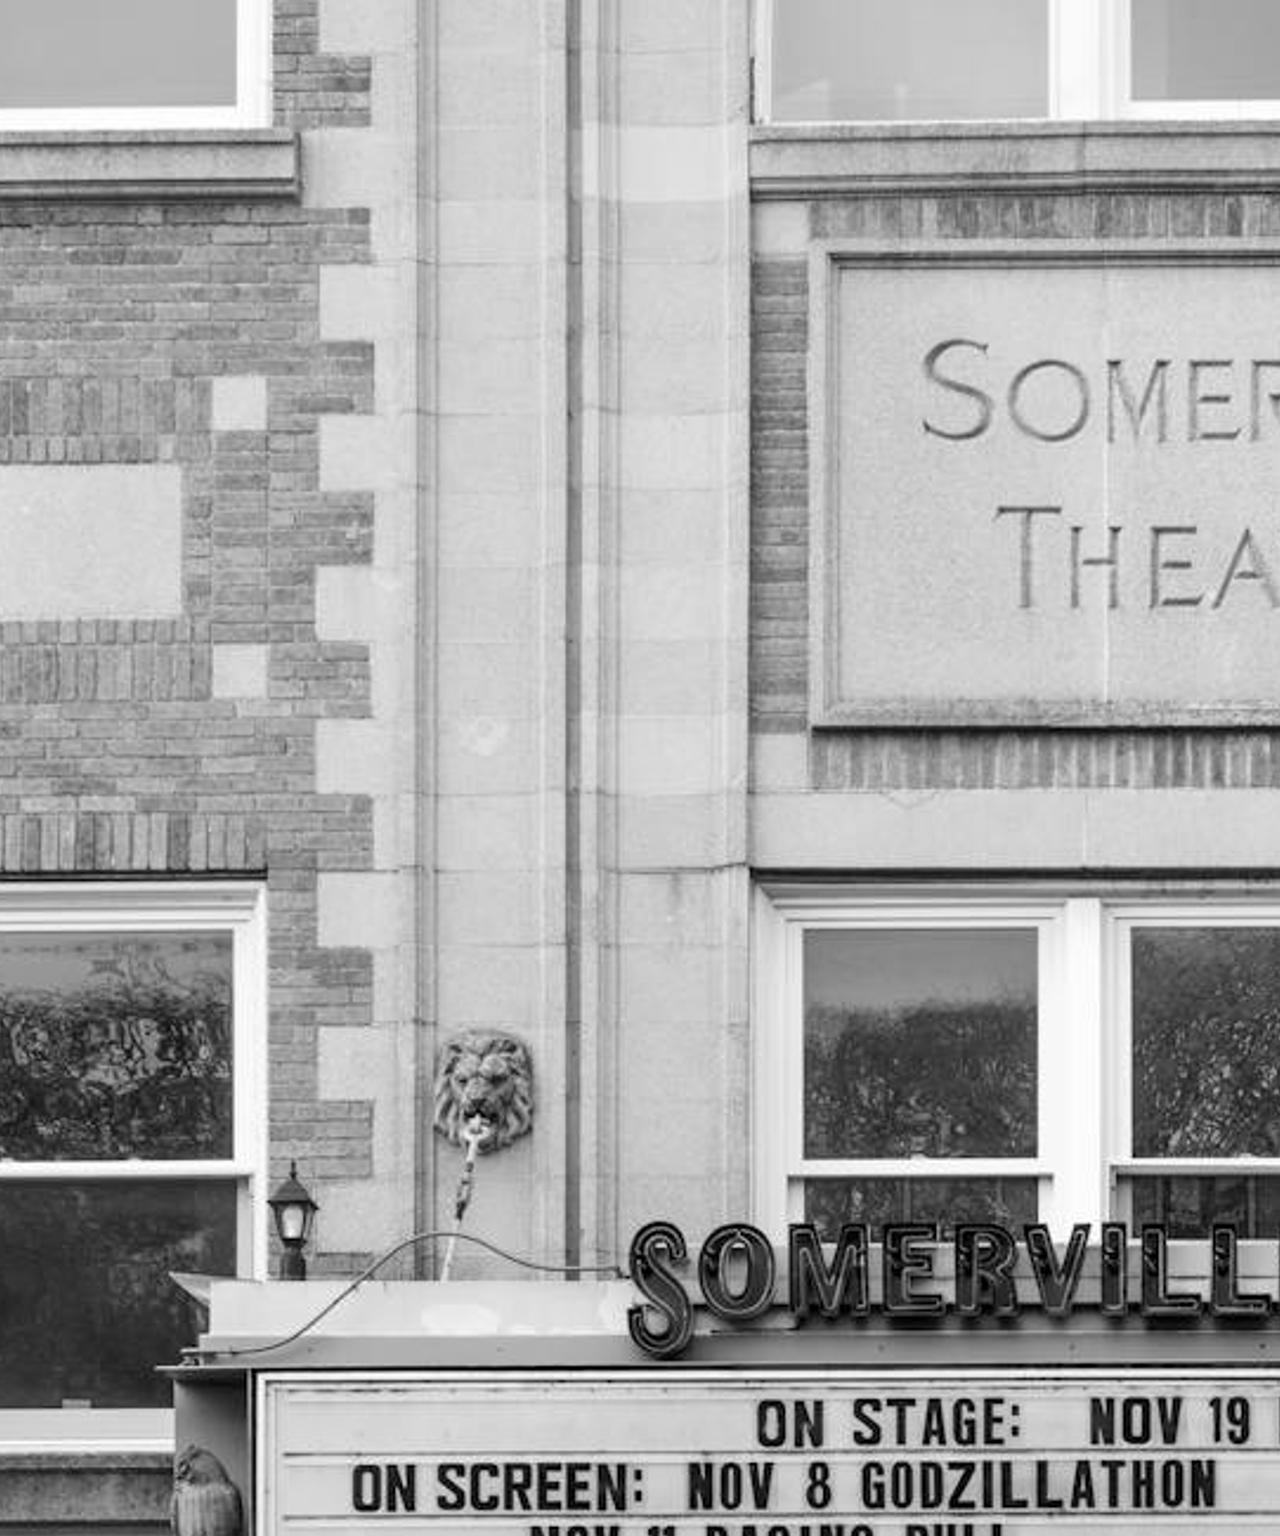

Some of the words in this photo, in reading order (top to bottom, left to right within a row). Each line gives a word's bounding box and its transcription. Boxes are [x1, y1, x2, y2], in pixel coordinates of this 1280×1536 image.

[757, 1399, 824, 1448] ON
[853, 1397, 1020, 1447] STAGE:
[1090, 1396, 1183, 1445] NOV
[1209, 1396, 1250, 1445] 19
[352, 1464, 416, 1513] ON
[437, 1462, 643, 1512] SCREEN:
[688, 1462, 775, 1511] NOV
[806, 1461, 832, 1510] 8
[861, 1459, 1216, 1510] GODZILLATHON
